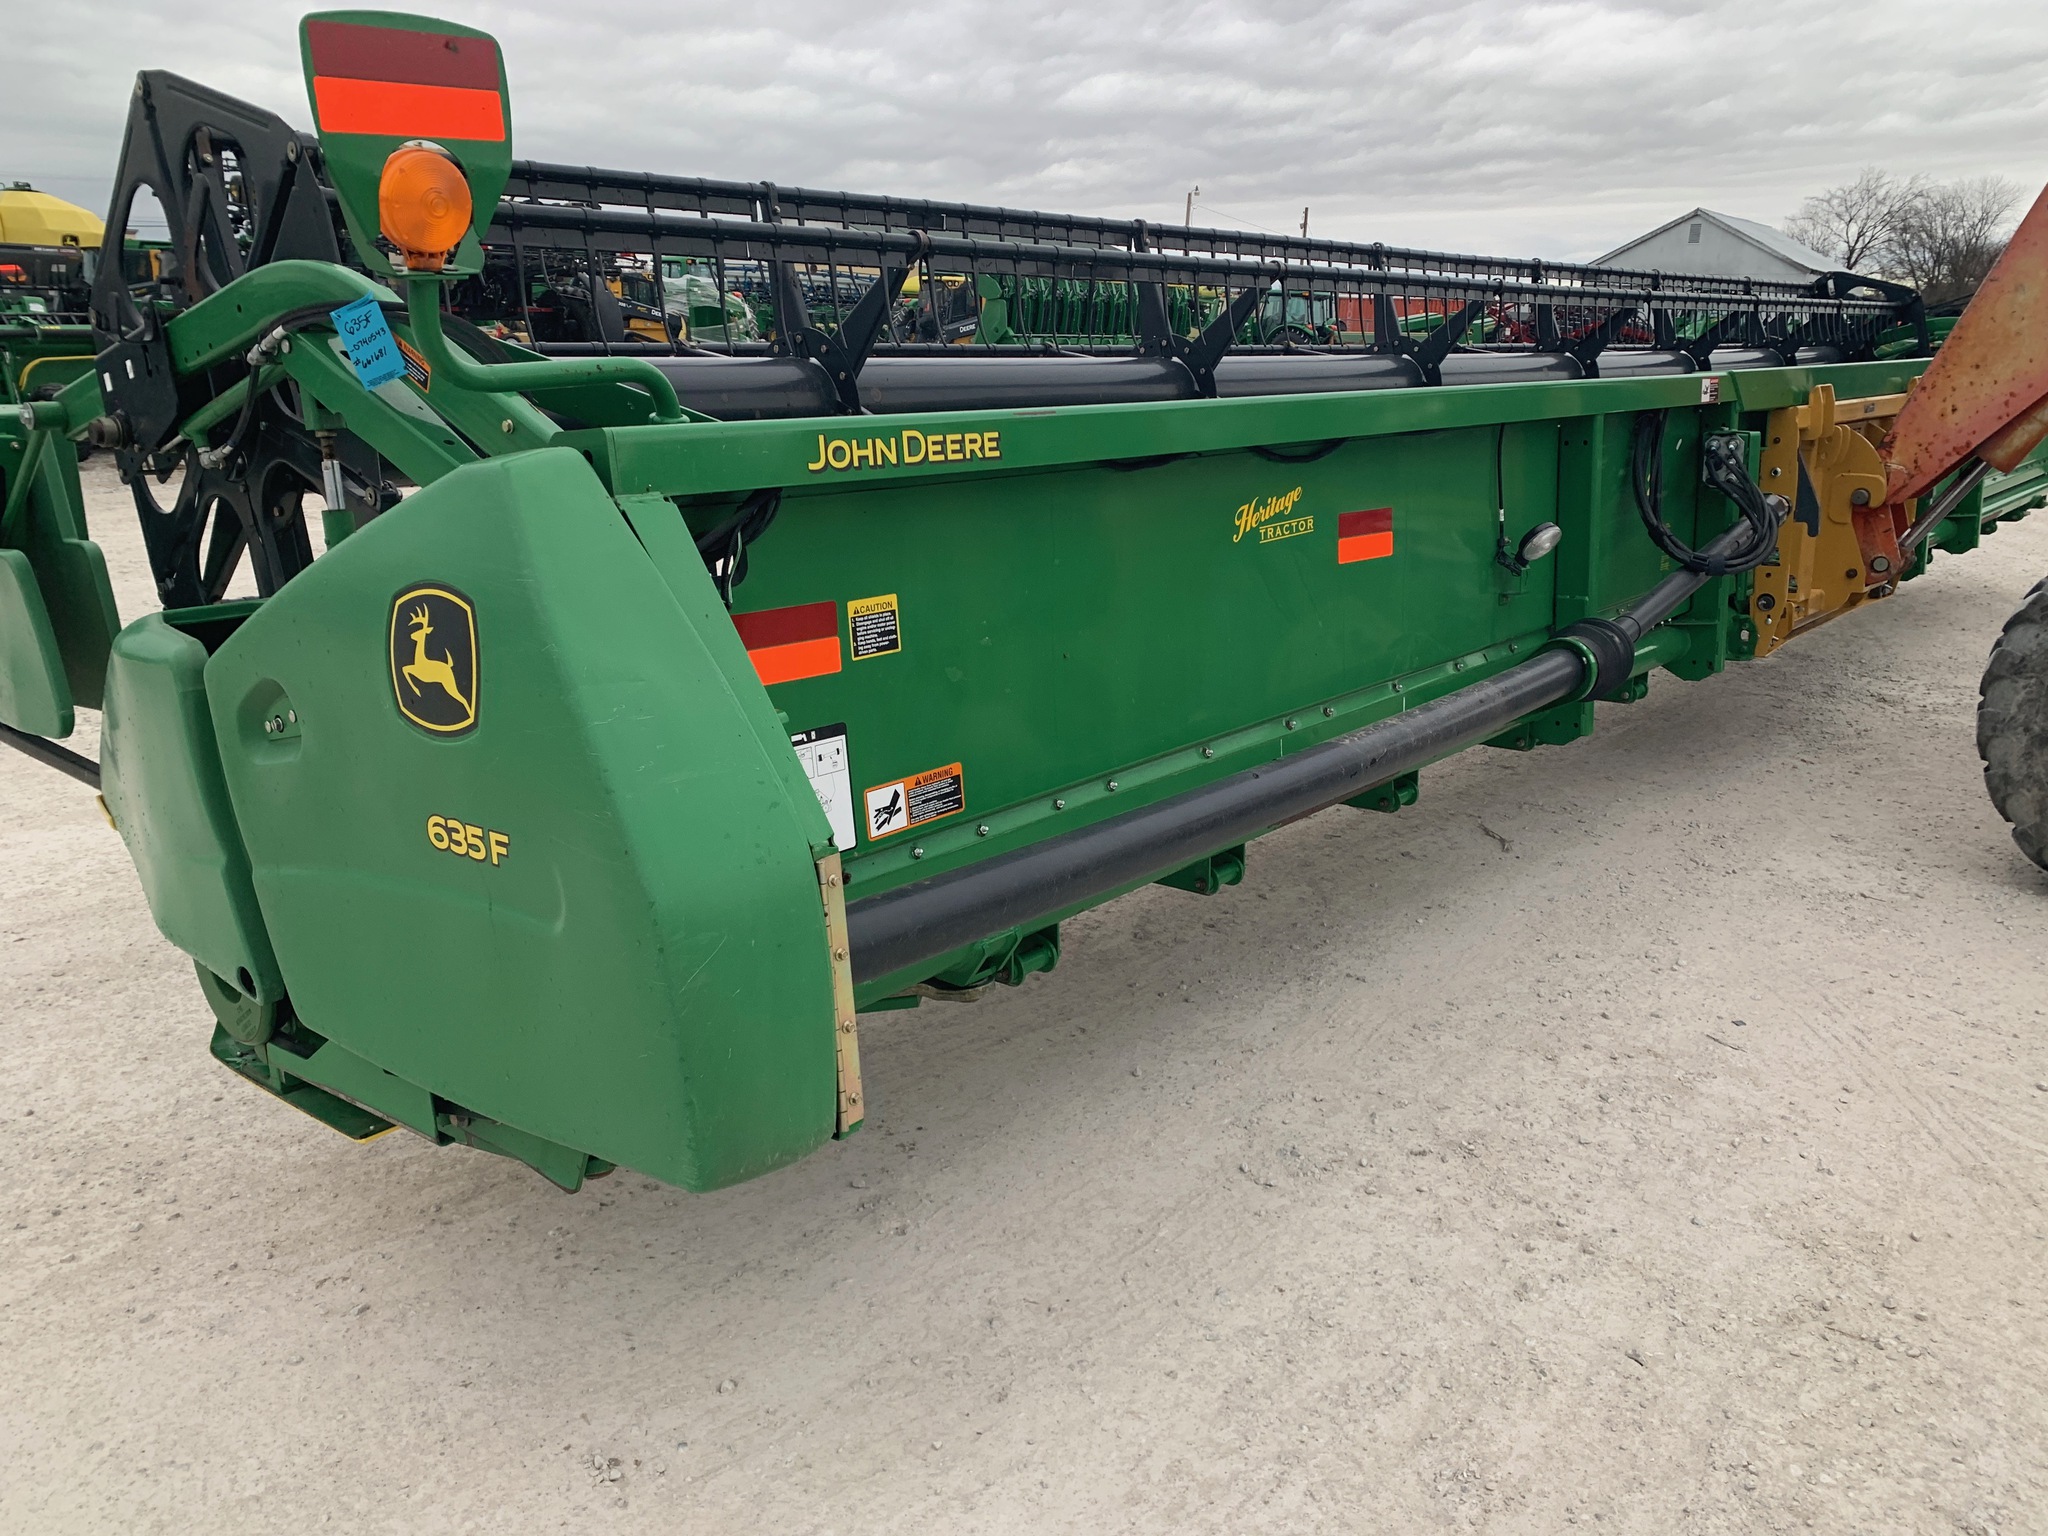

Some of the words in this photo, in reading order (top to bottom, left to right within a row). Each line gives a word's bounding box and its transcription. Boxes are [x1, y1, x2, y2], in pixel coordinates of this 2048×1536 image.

[344, 309, 372, 335] 635F
[960, 323, 976, 333] DEERE
[808, 434, 899, 472] JOHN
[901, 429, 1002, 465] DEERE
[1233, 486, 1303, 543] Heritage
[1259, 518, 1314, 541] TRACTOR
[860, 601, 893, 614] CAUTION
[922, 767, 954, 784] WARNING
[426, 813, 510, 868] 635F
